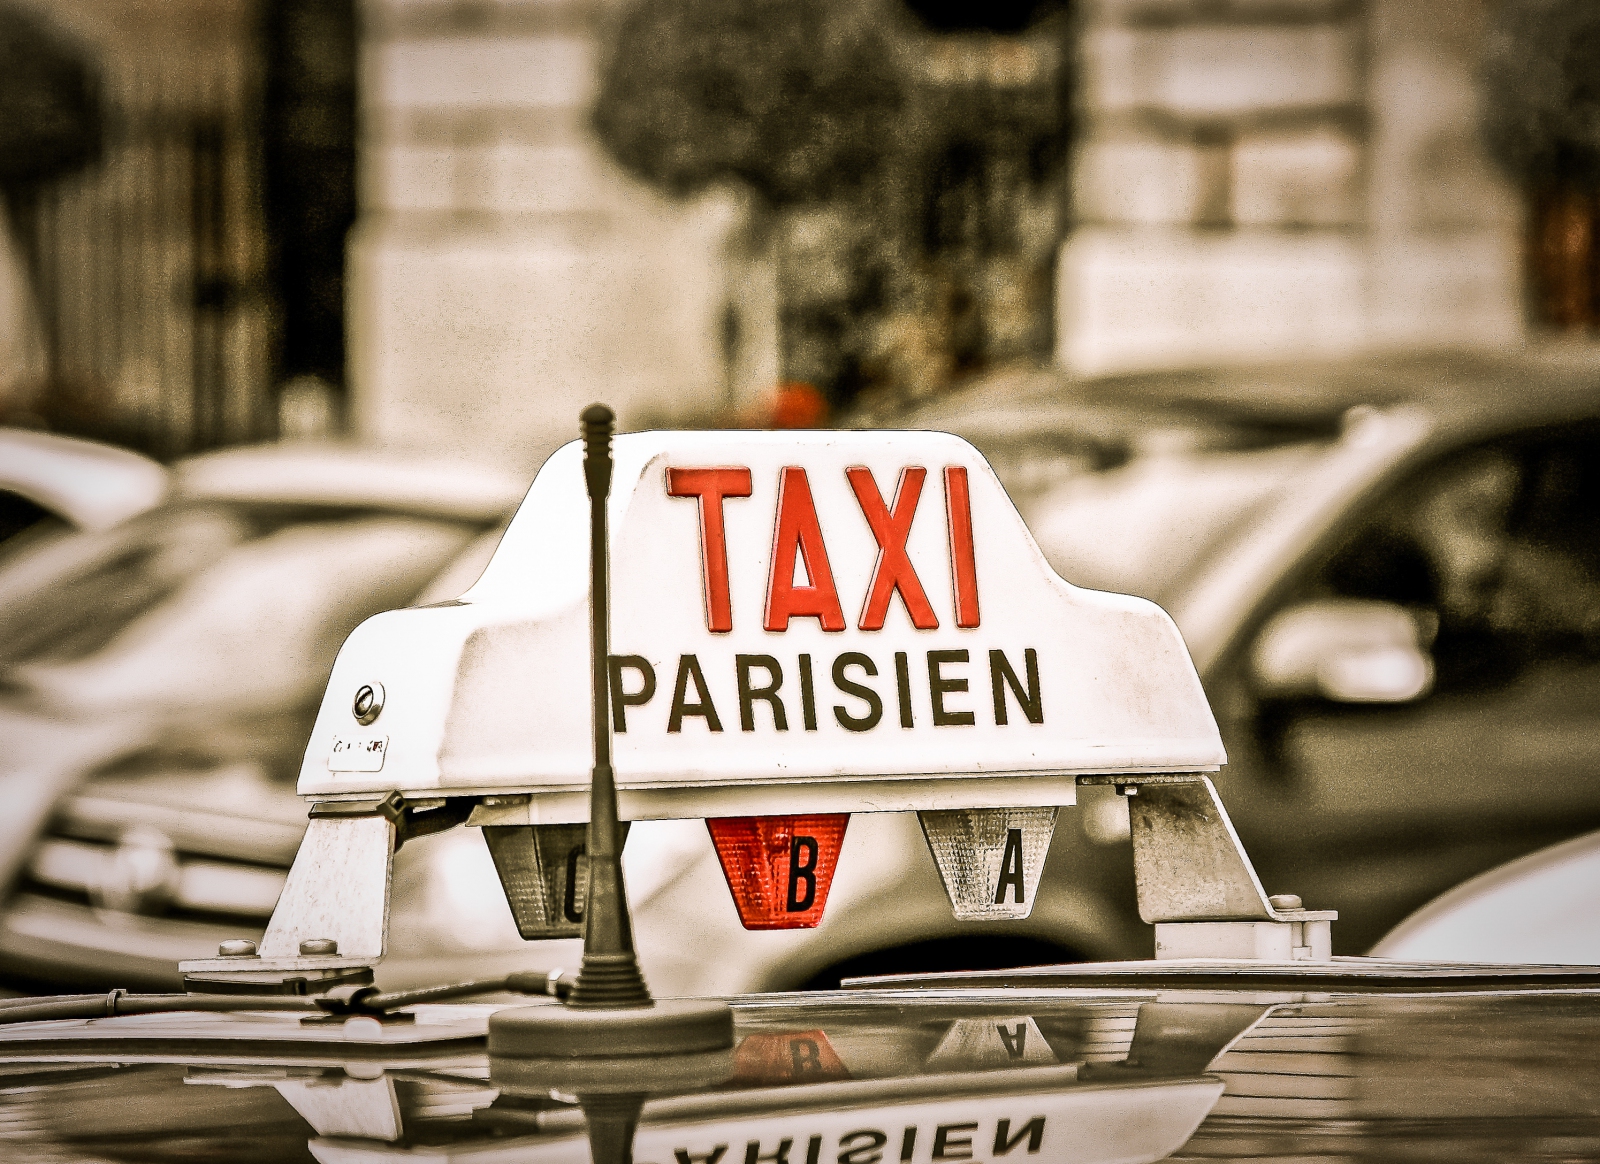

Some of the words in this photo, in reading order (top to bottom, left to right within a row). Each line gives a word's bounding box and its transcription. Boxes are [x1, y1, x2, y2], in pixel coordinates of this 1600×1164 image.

[665, 466, 980, 632] TAXI
[608, 648, 1044, 733] PARISIEN
[786, 836, 819, 912] B
[994, 828, 1025, 904] A
